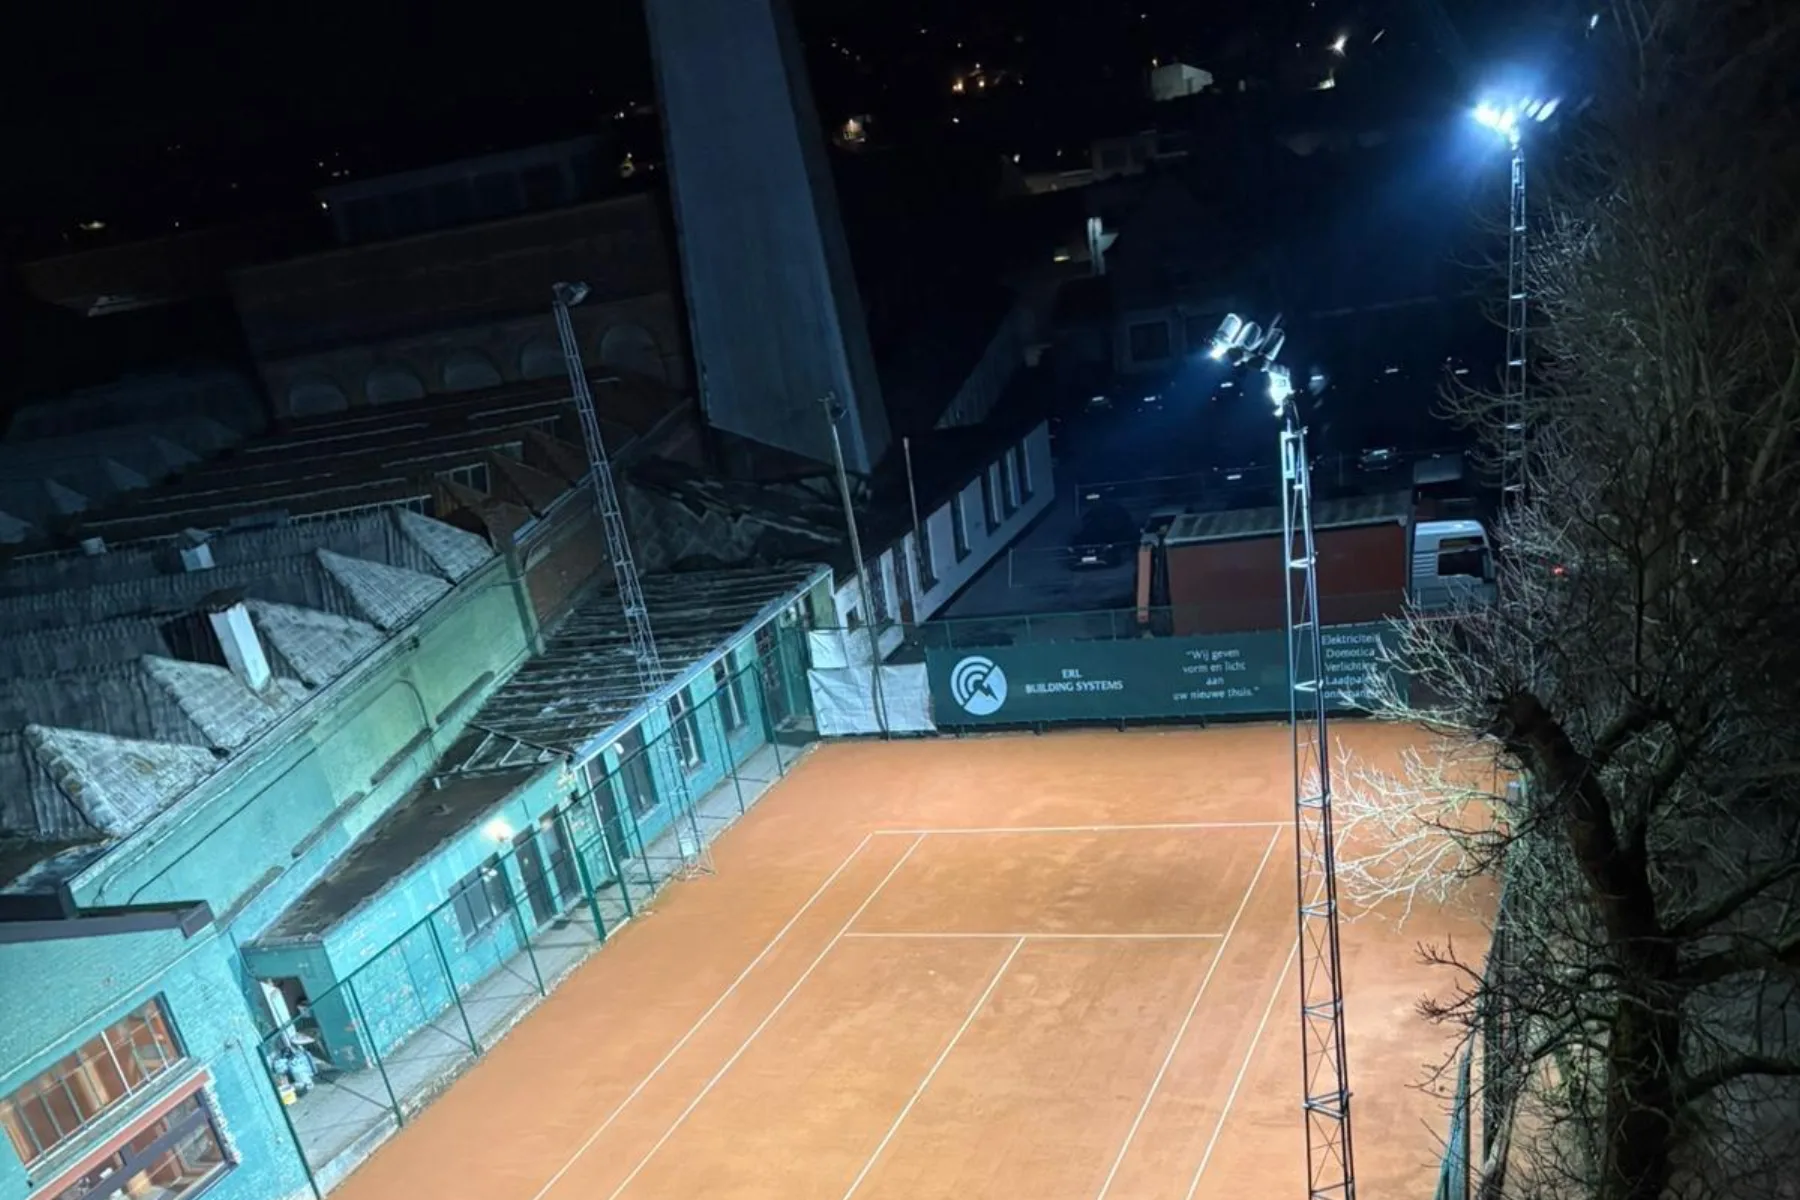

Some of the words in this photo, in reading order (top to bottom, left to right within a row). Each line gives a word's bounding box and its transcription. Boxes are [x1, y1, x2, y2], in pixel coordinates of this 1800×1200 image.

[1211, 649, 1240, 661] geven
[1325, 648, 1375, 658] Domotica
[1182, 664, 1209, 674] vorm
[1210, 664, 1223, 673] en
[1225, 660, 1247, 672] licht
[1061, 668, 1083, 679] ERL
[1205, 676, 1225, 686] aan
[1325, 675, 1377, 686] Laadpal
[1025, 682, 1074, 694] BUILDING
[1075, 680, 1124, 691] SYSTEMS
[1172, 692, 1188, 701] uw
[1190, 688, 1225, 699] nieuwe
